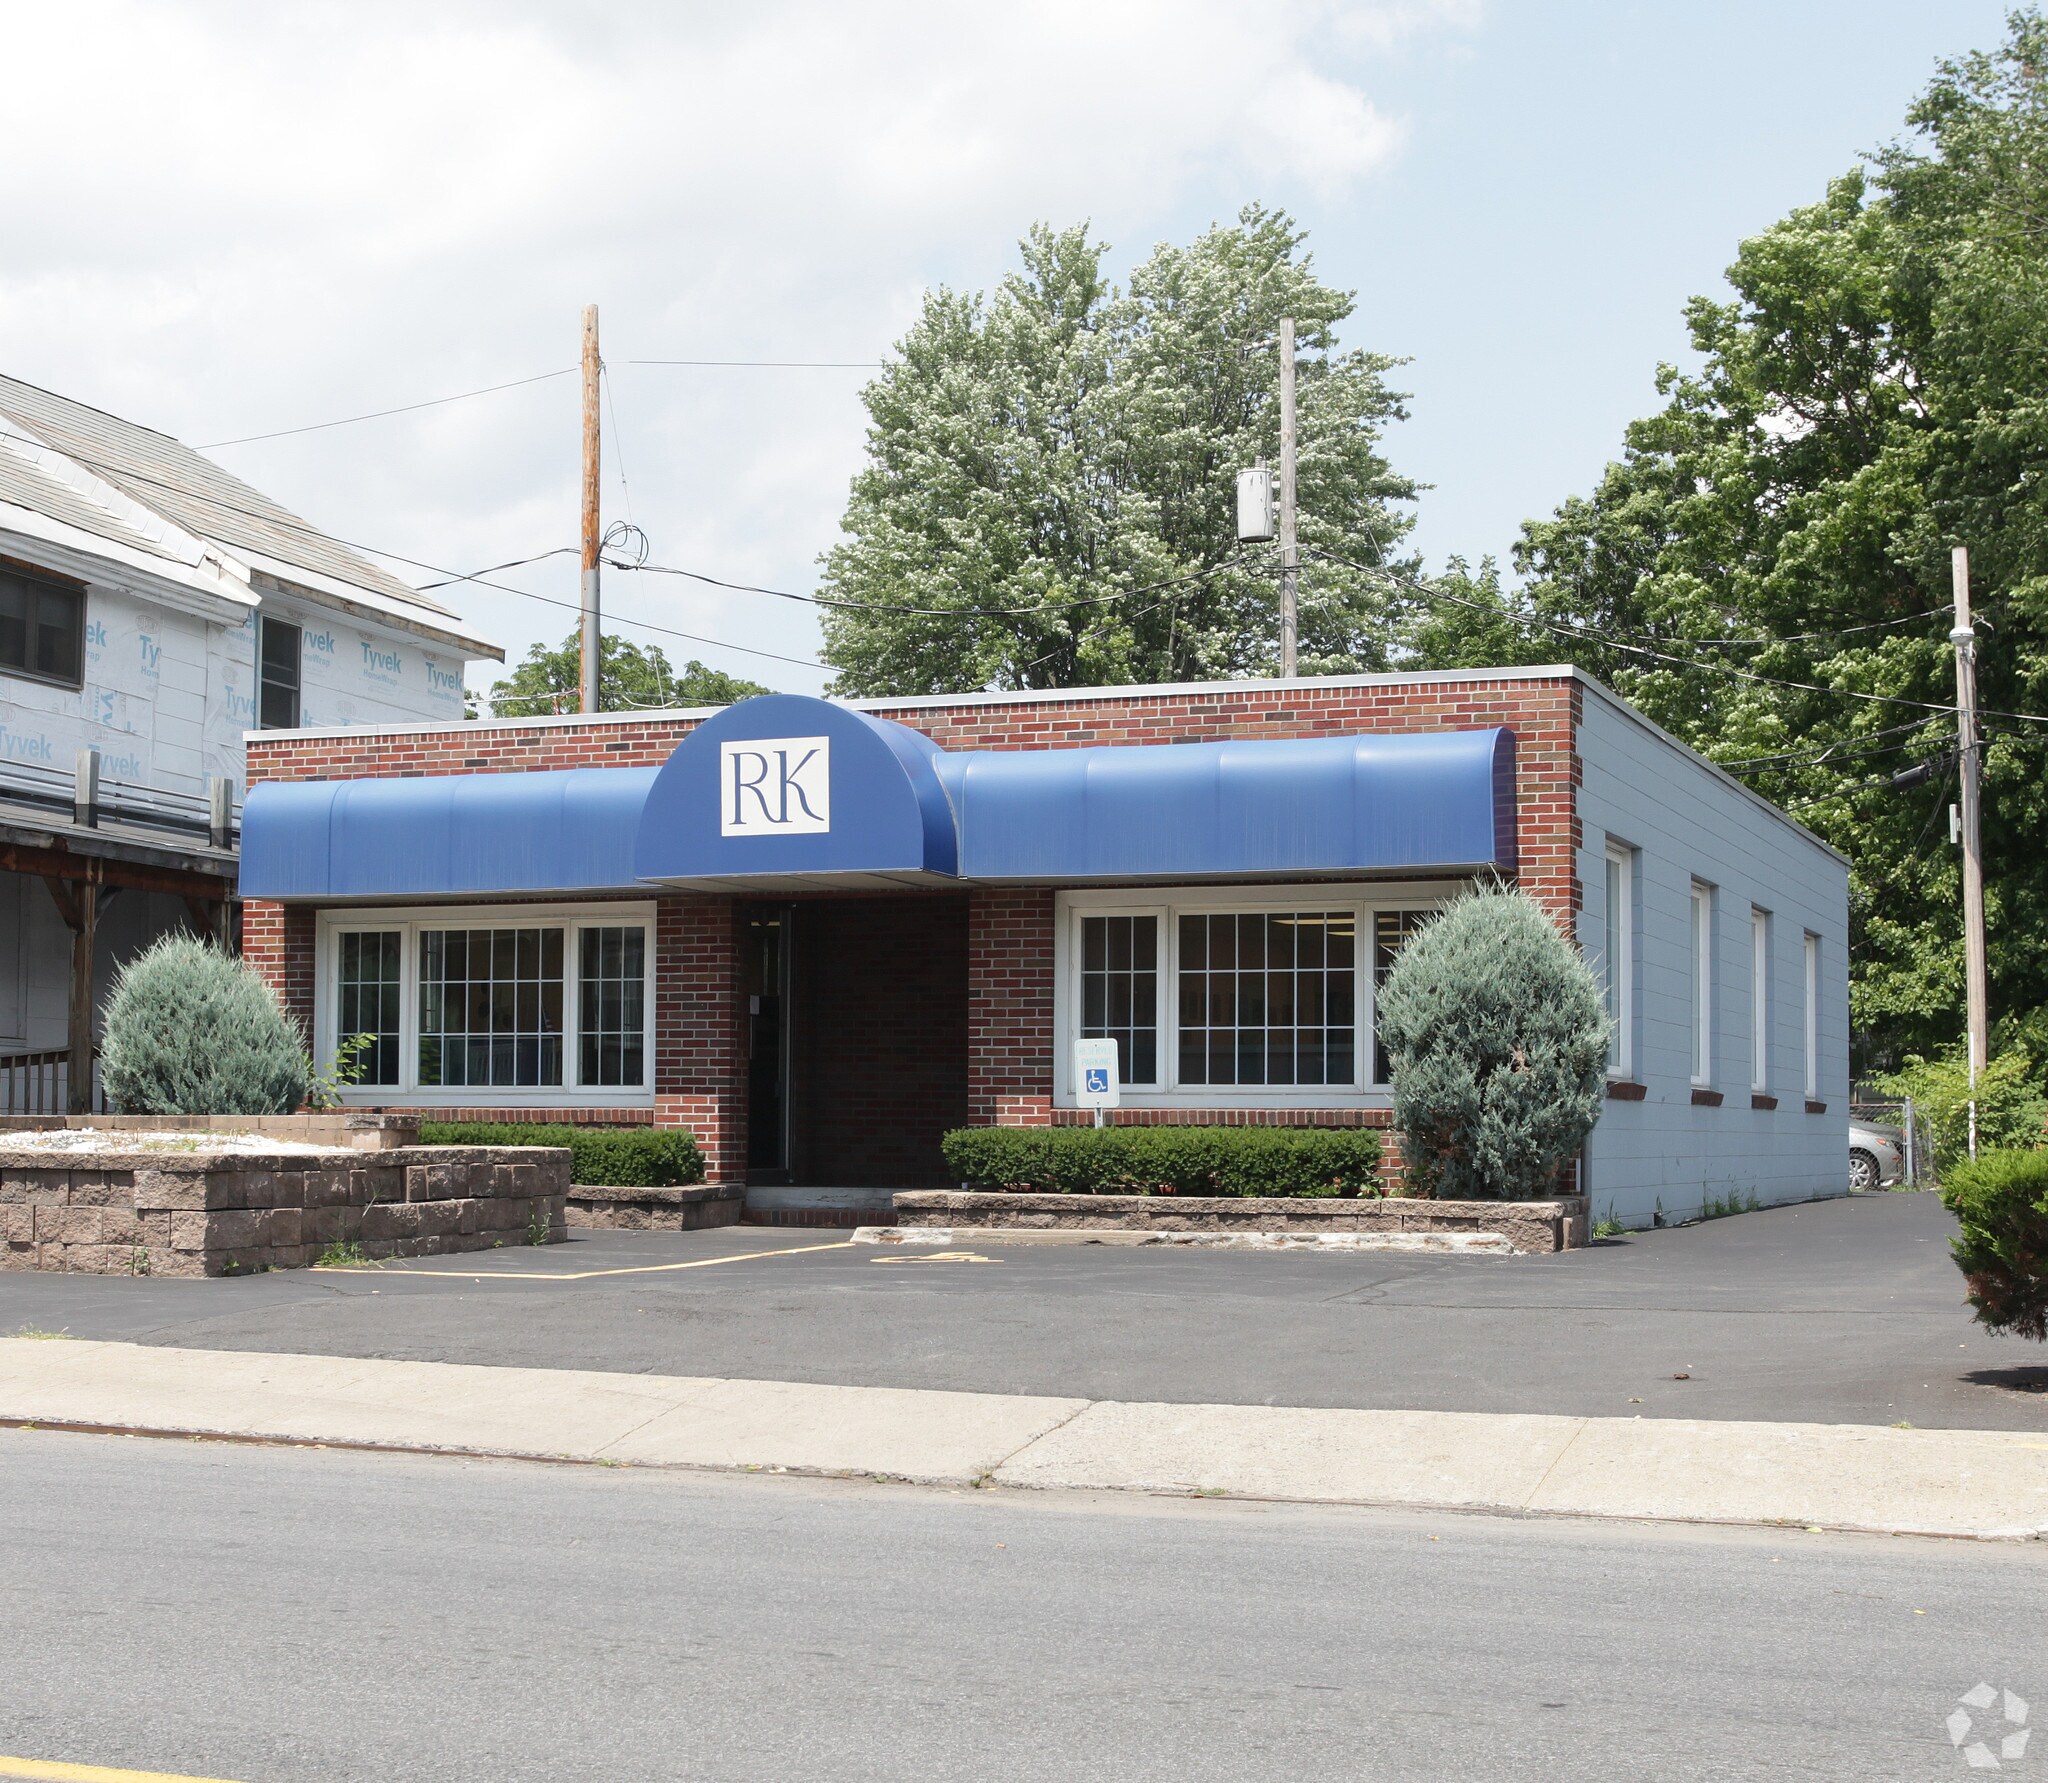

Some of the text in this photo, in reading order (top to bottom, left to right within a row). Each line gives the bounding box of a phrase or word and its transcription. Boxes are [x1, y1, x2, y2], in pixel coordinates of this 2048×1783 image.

[361, 642, 402, 675] Tyvek
[363, 669, 399, 687] HomeWrap
[425, 661, 464, 693] Tyvek
[728, 749, 825, 825] RK
